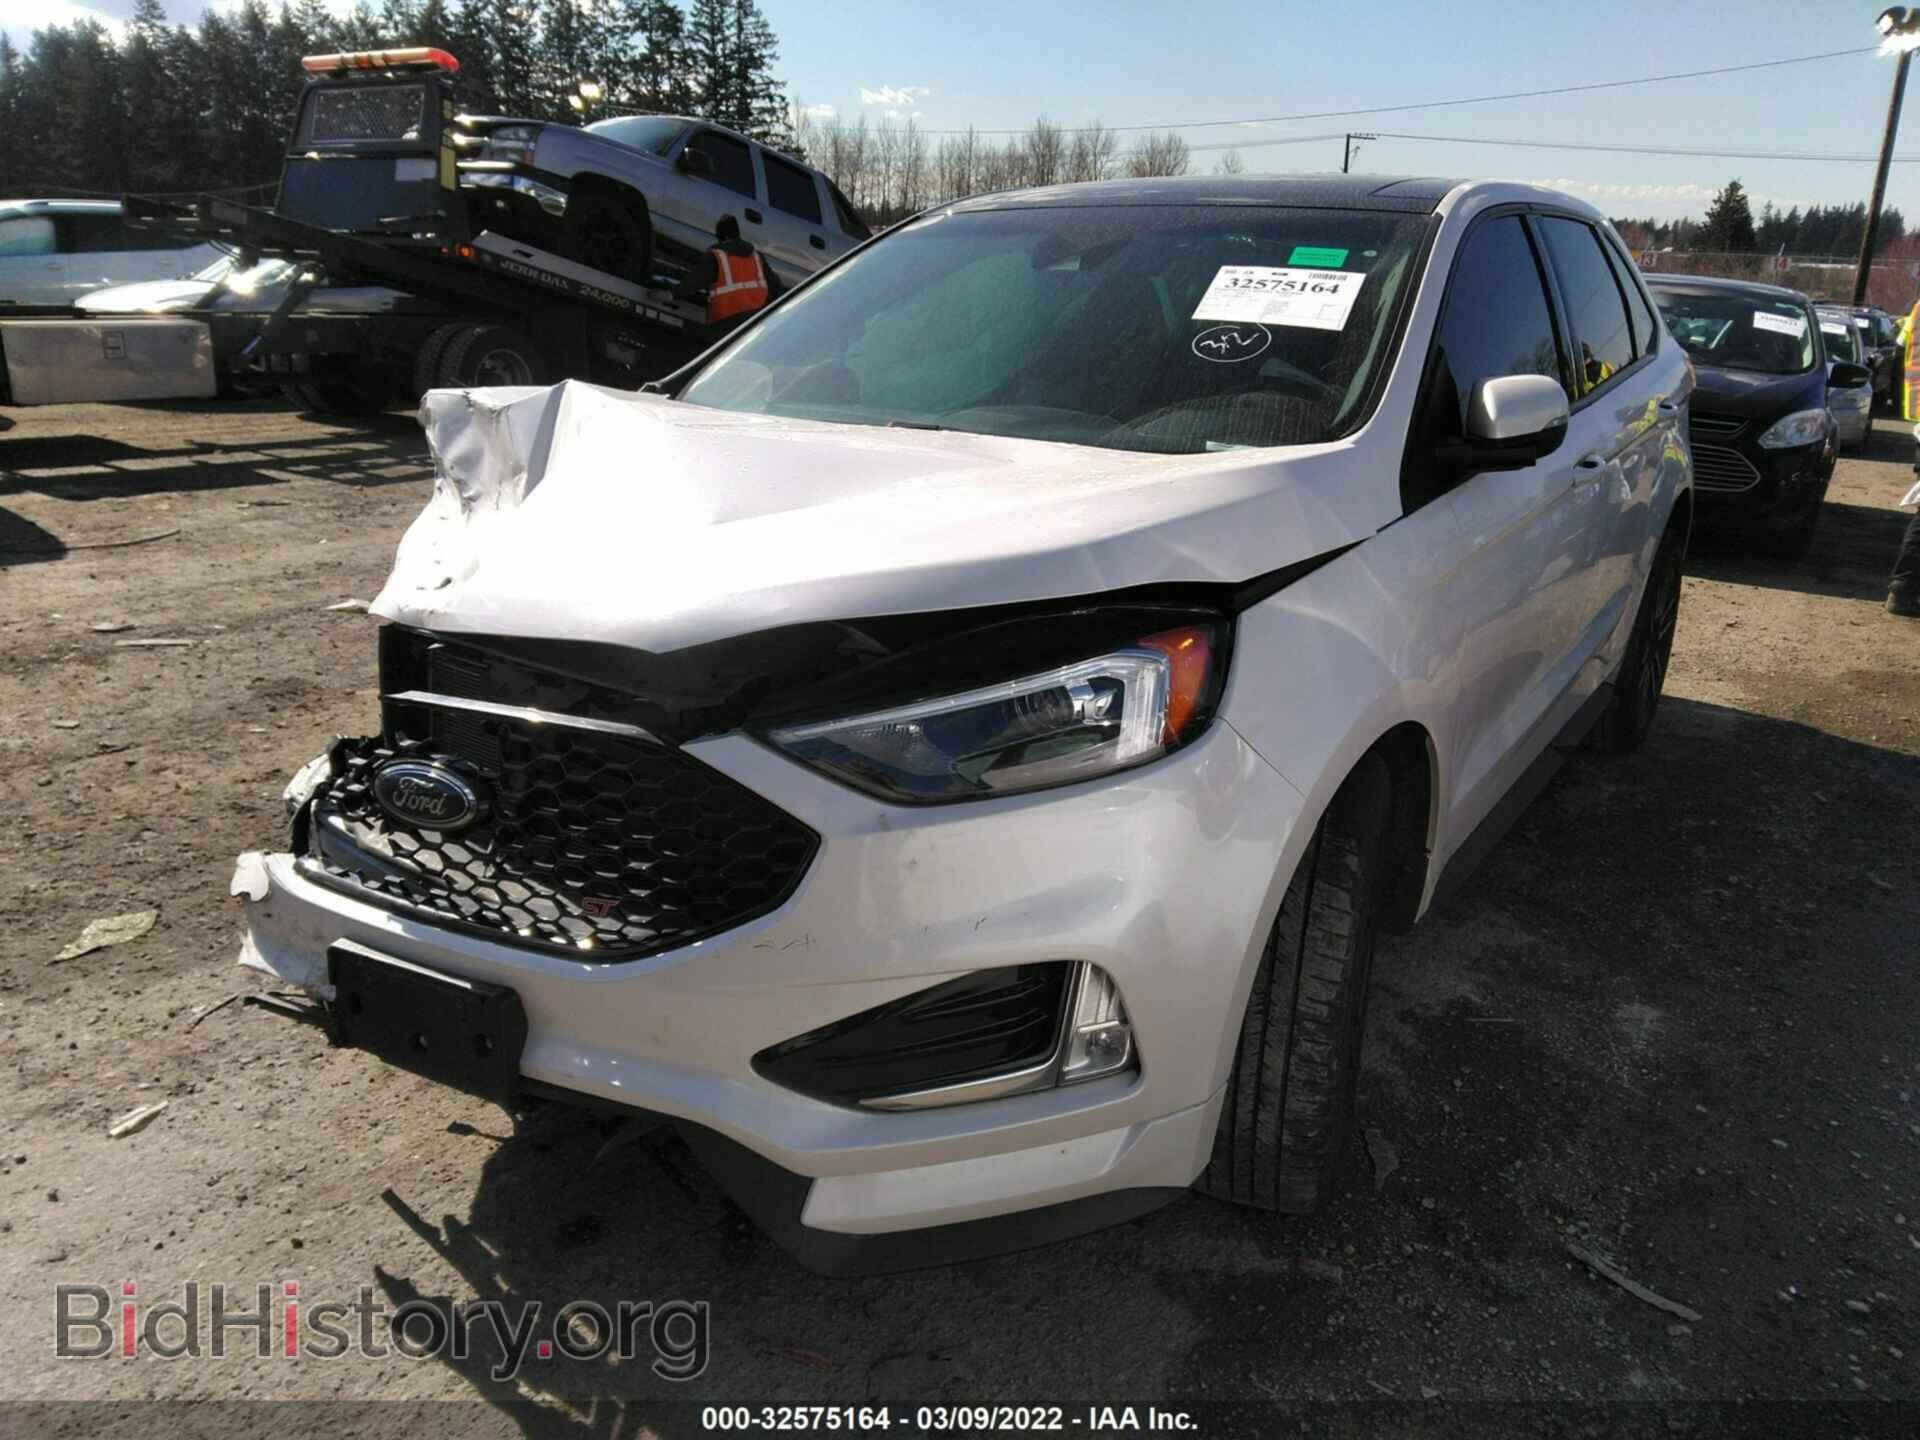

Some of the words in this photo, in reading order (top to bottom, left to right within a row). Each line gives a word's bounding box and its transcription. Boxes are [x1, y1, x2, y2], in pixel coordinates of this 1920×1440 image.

[1224, 277, 1341, 295] 32575164
[393, 776, 448, 815] Ford
[582, 896, 620, 918] ST
